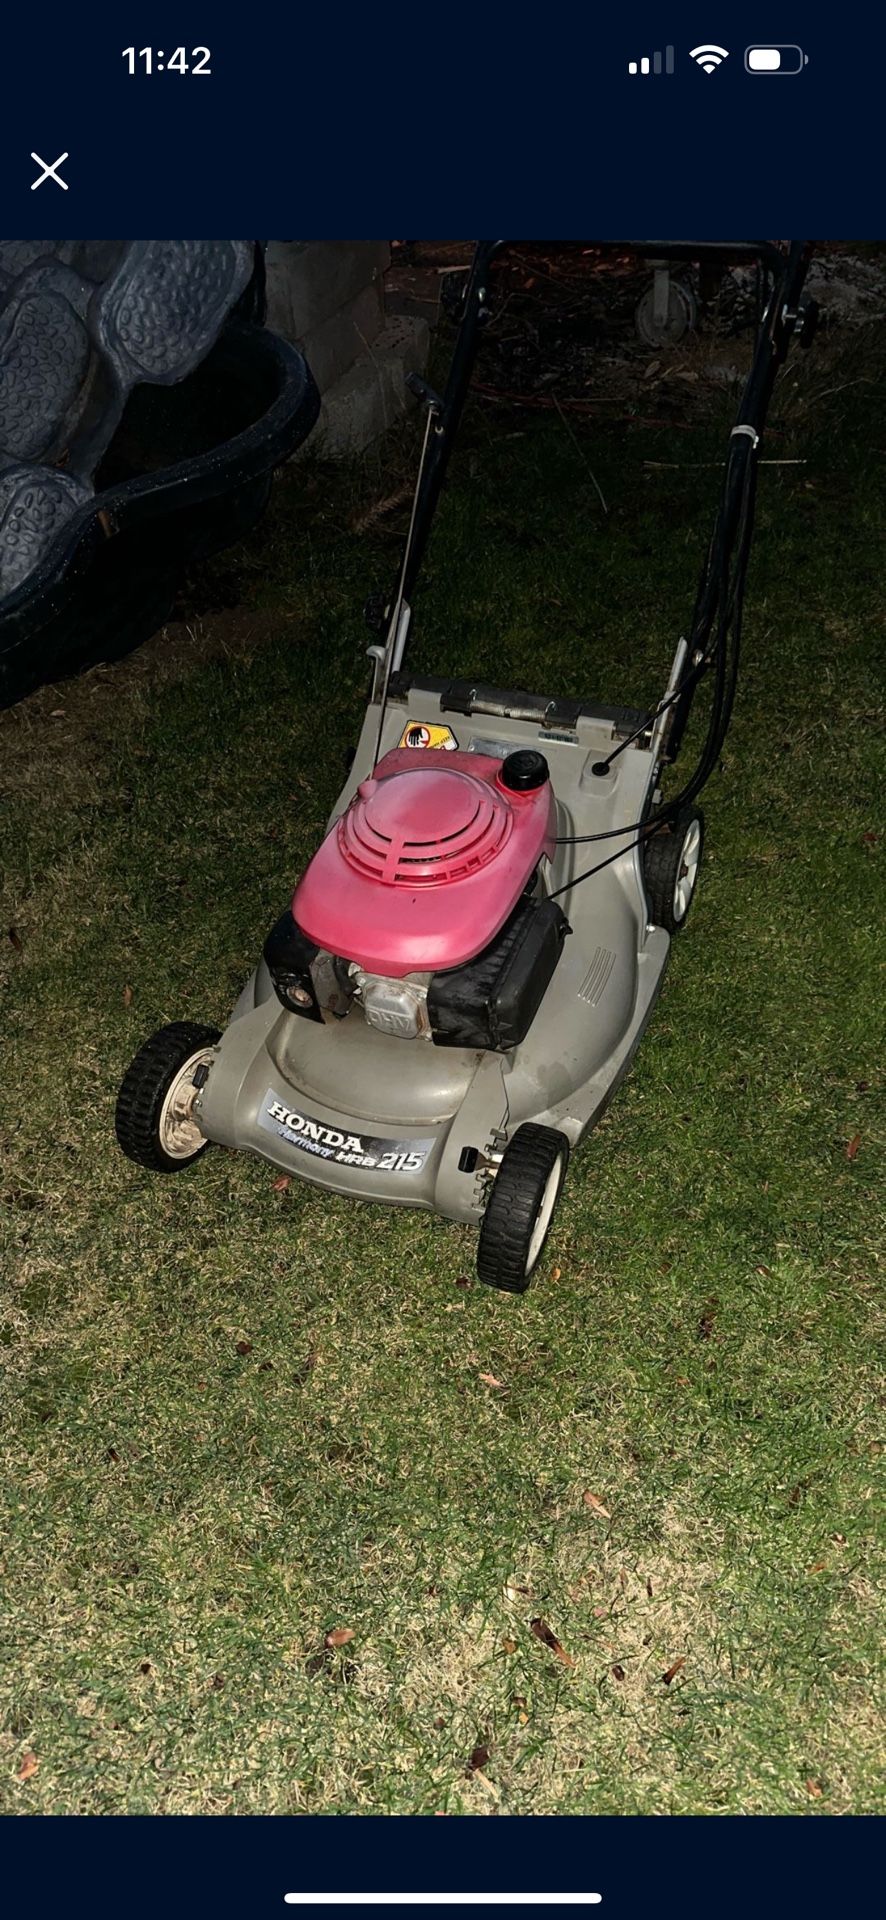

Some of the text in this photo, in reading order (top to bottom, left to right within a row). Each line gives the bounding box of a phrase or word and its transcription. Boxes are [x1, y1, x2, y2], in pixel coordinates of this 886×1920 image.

[266, 1101, 364, 1153] HONDA
[277, 1127, 425, 1170] Harmony HRB 215
